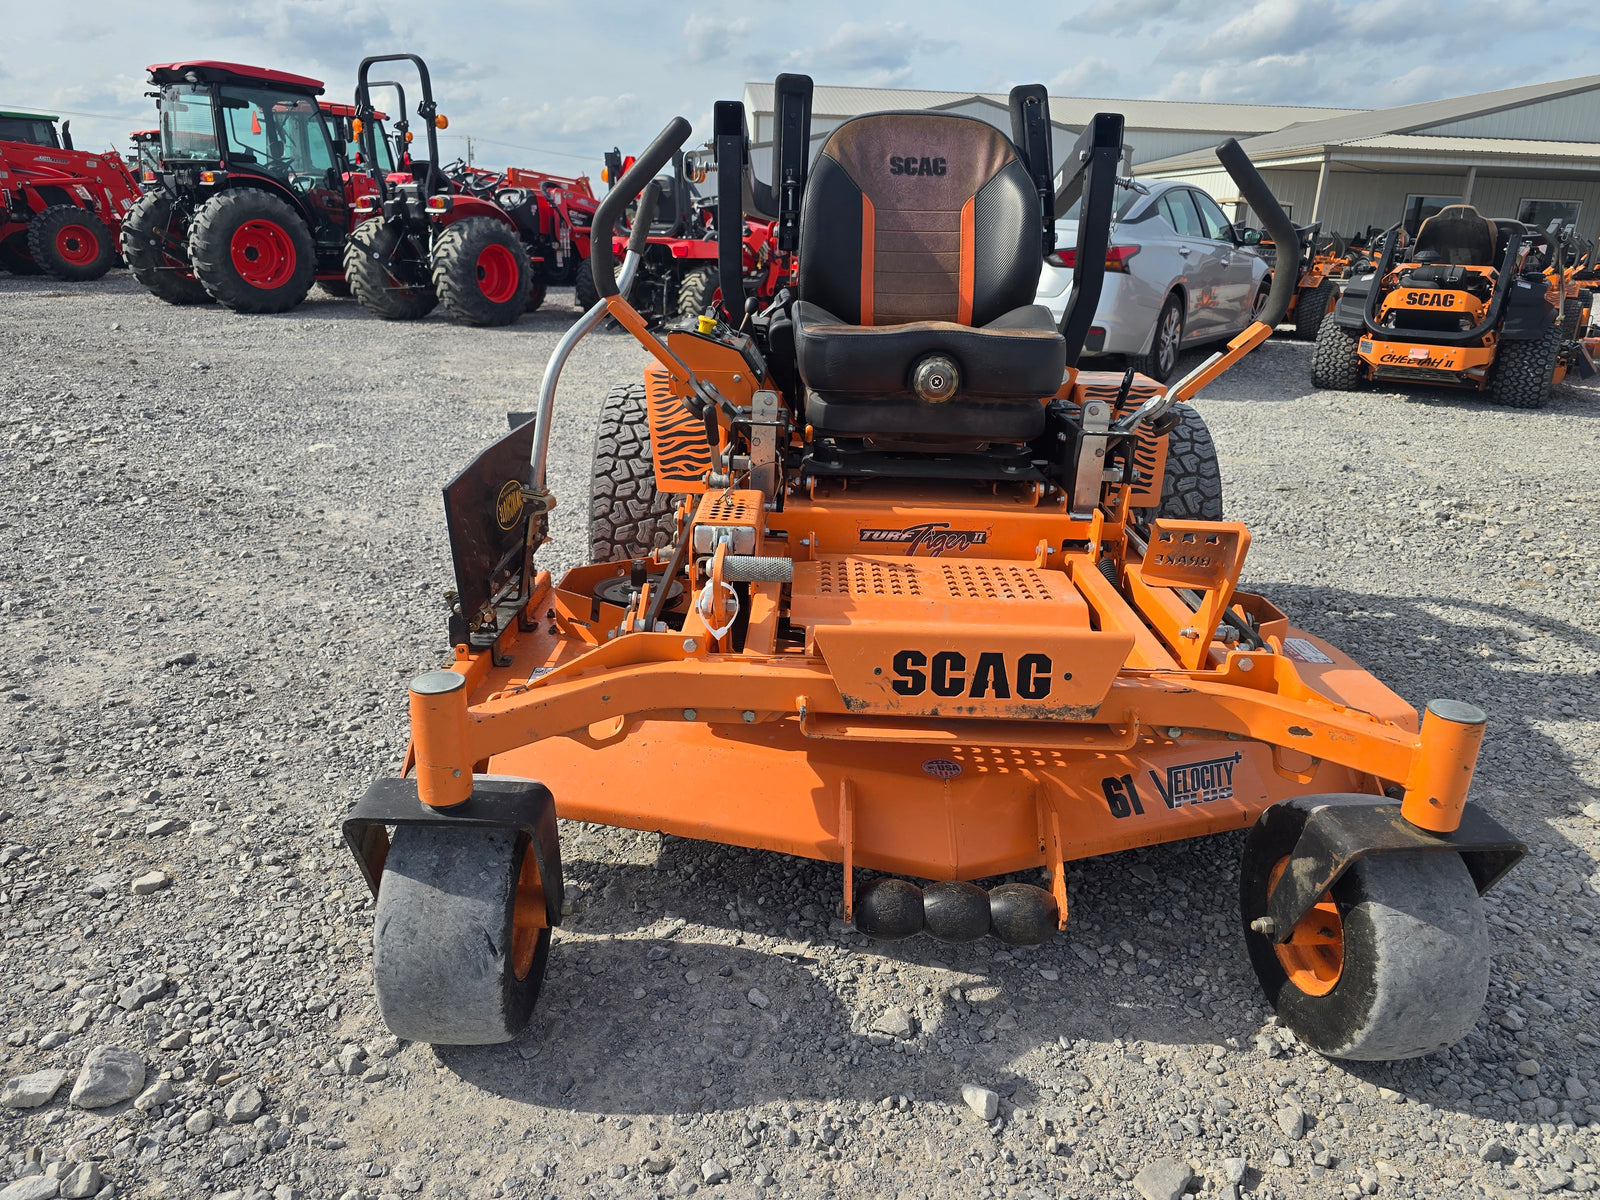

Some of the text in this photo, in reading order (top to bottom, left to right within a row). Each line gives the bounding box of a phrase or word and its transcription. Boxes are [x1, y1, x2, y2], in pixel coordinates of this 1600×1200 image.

[889, 156, 947, 176] SCAG
[1406, 292, 1455, 307] SCAG
[1444, 360, 1454, 368] II
[861, 522, 985, 557] TURF Tiger II
[892, 650, 1053, 700] SCAG
[937, 764, 960, 772] USA
[1101, 774, 1145, 819] 61
[1174, 786, 1234, 808] PLUS
